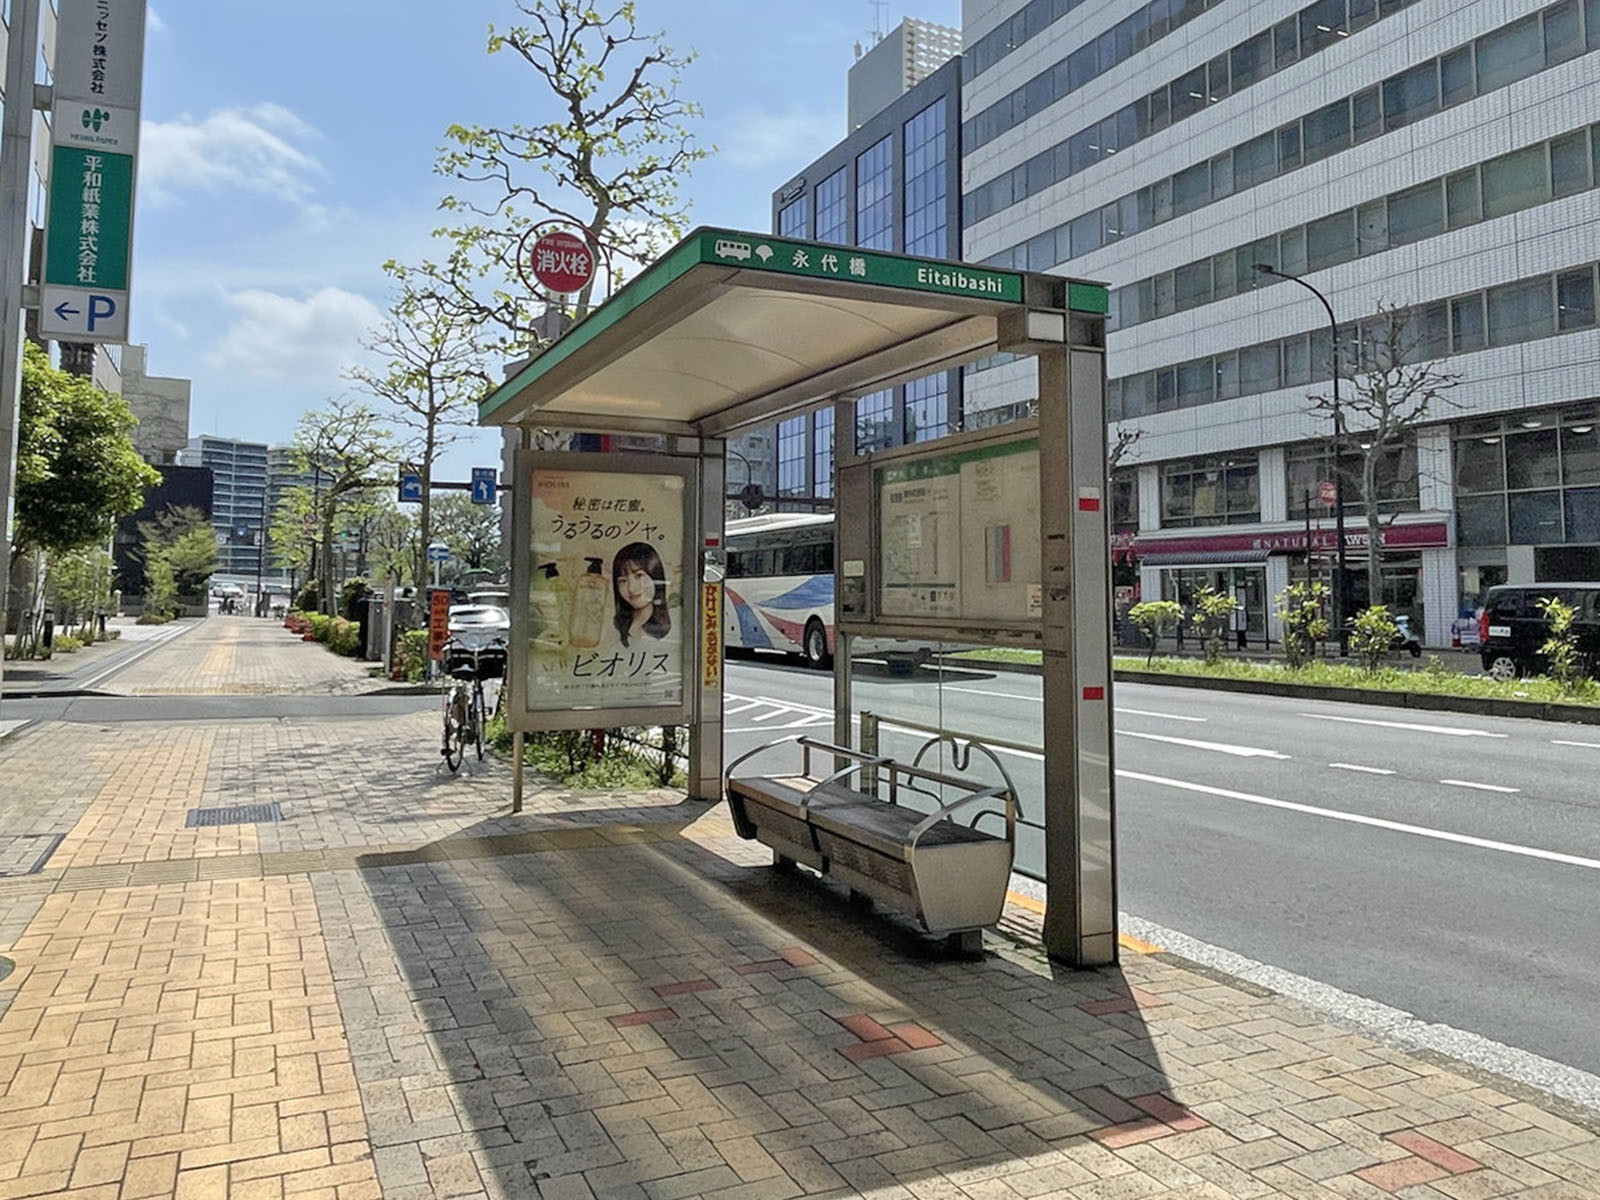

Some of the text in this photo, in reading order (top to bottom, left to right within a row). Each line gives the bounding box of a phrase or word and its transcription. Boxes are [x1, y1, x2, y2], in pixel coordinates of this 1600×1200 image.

[77, 155, 103, 283] 平和紙業株式会社
[536, 248, 589, 276] 消火栓
[792, 249, 866, 277] 永代橋
[917, 267, 1003, 293] Eitaibashi
[88, 295, 116, 332] P
[552, 514, 665, 540] うるうるのツヤ。
[573, 651, 669, 678] ビオリス
